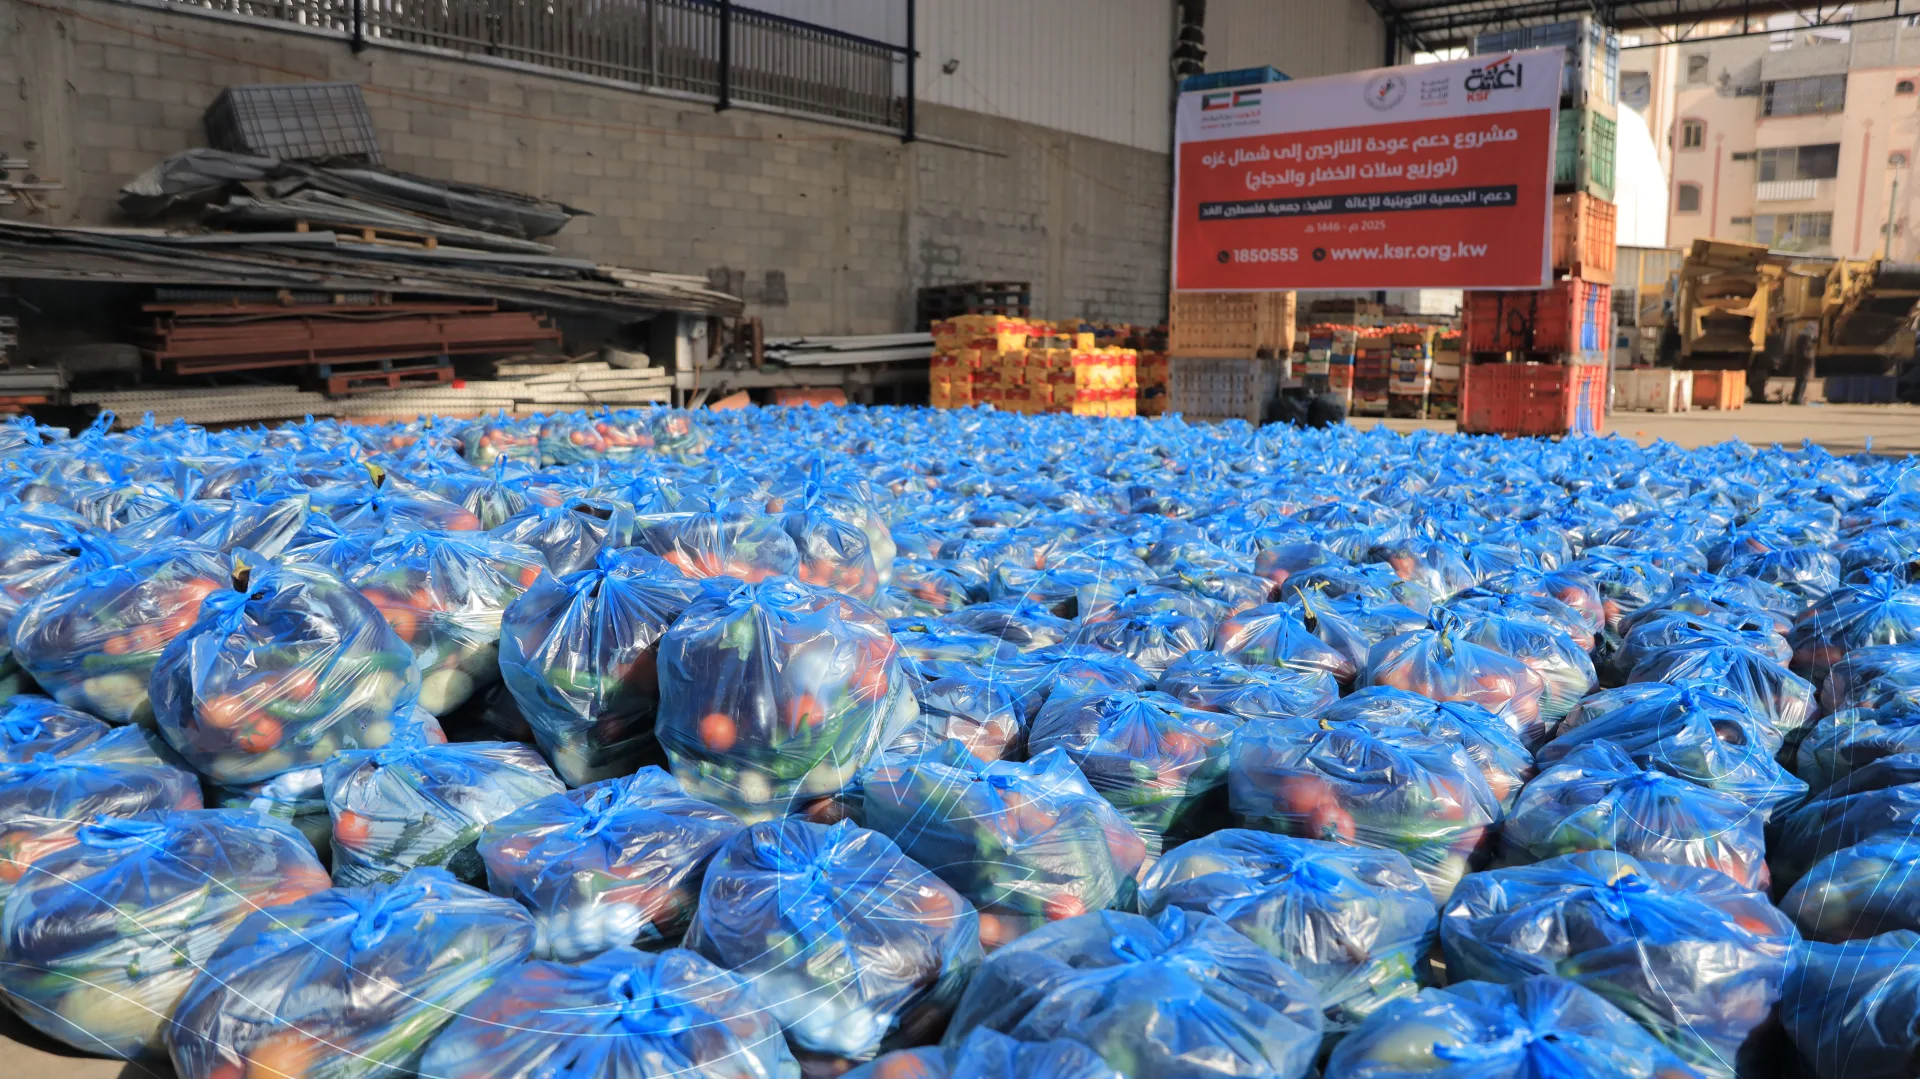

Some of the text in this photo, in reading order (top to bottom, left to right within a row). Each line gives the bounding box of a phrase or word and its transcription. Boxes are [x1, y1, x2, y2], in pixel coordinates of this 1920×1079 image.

[1365, 137, 1409, 155] عودة
[1412, 133, 1450, 152] دعم
[1453, 124, 1518, 149] مشروع
[1228, 144, 1271, 166] شمال
[1273, 143, 1302, 162] إلى
[1305, 137, 1363, 160] النازحين
[1245, 155, 1458, 191] (توزيع سلات الخضار والدجاج)
[1201, 190, 1512, 217] دعم: الجمعية الكويتية للإغاثة تنفيذ: جمعية فلسطين الغد
[1316, 221, 1340, 232] 1446
[1348, 222, 1359, 234] م
[1360, 220, 1386, 232] 2025
[1233, 241, 1488, 263] 1850555 www.ksr.org.kw
